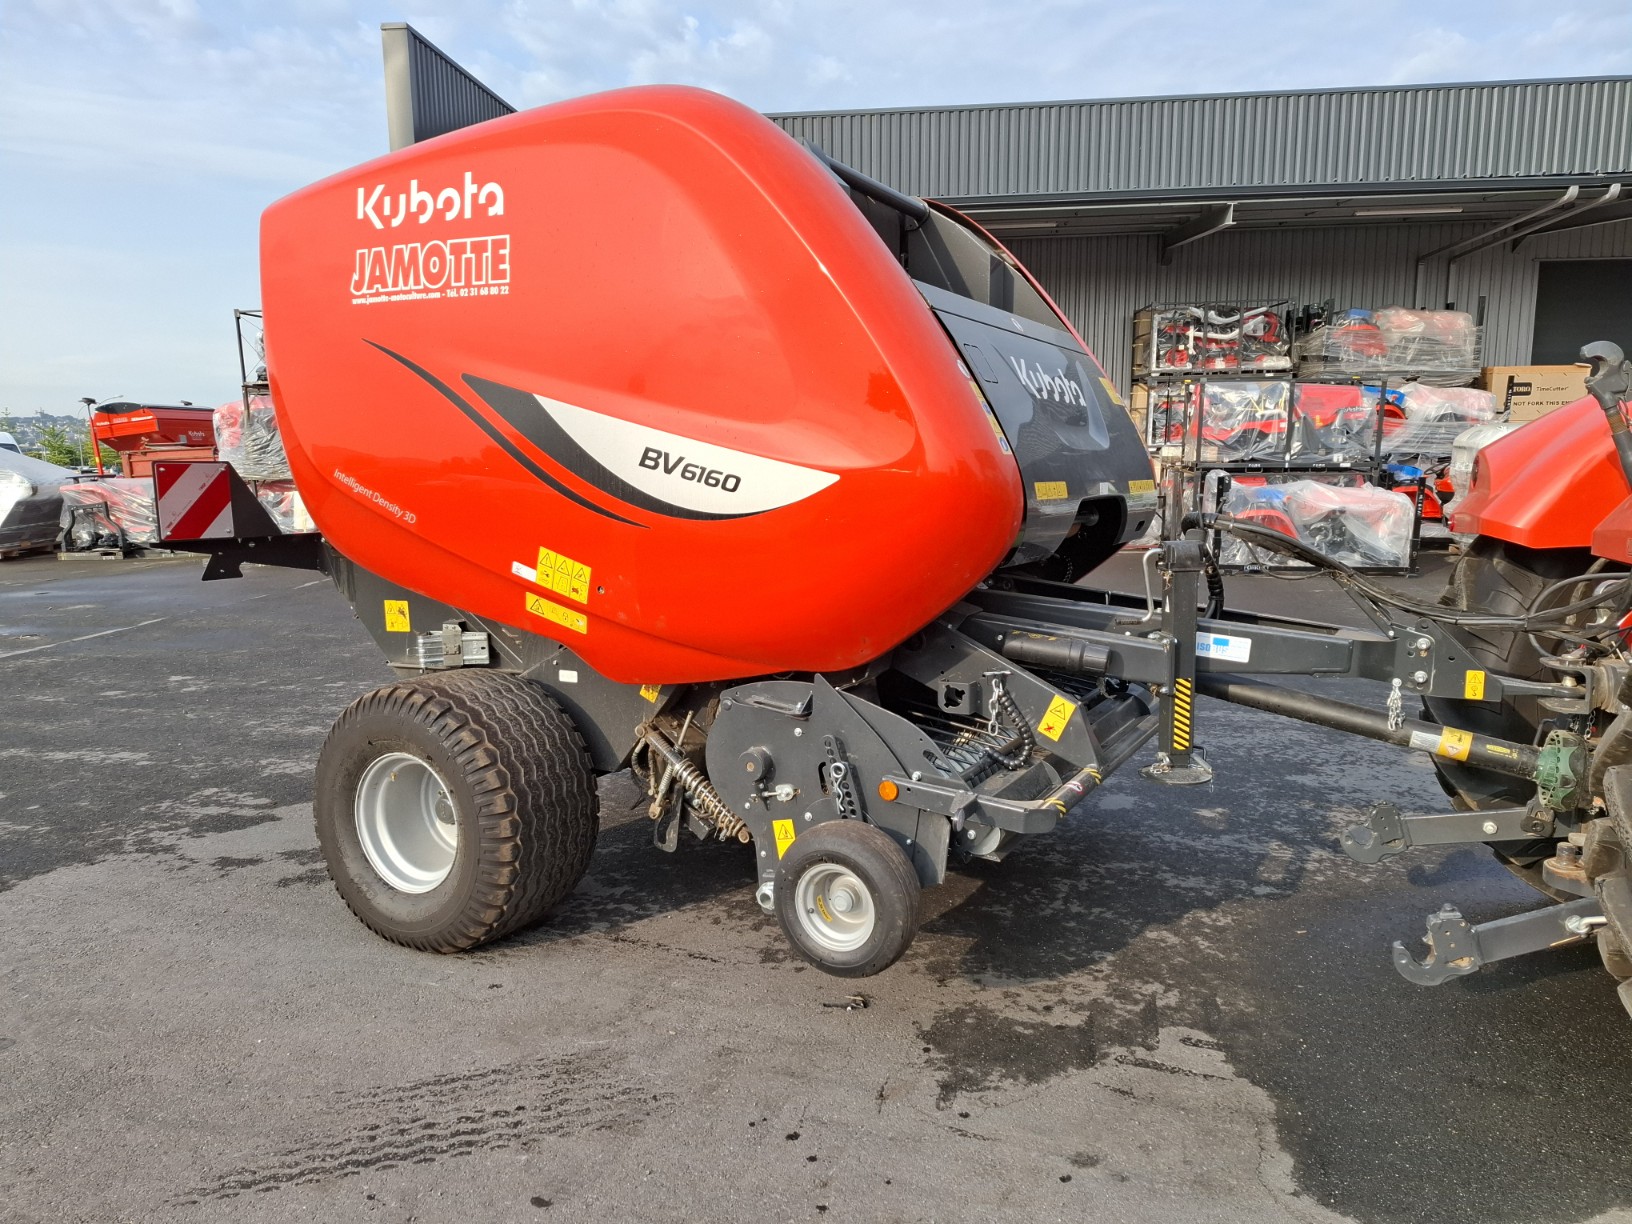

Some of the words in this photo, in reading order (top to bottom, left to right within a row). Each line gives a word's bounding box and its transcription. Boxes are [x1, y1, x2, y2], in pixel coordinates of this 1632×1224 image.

[357, 171, 504, 230] Kubota
[350, 234, 510, 295] JAMOTTE
[351, 291, 441, 305] www.jamotte-motoculture.com
[446, 288, 458, 298] Tél.
[459, 288, 469, 297] 02
[470, 287, 478, 296] 31
[479, 286, 489, 296] 68
[500, 285, 509, 295] 22
[1010, 356, 1087, 406] Kubota
[333, 468, 373, 499] Intelligent
[372, 492, 404, 517] Density
[403, 510, 416, 524] 3D
[638, 446, 741, 493] BV6160
